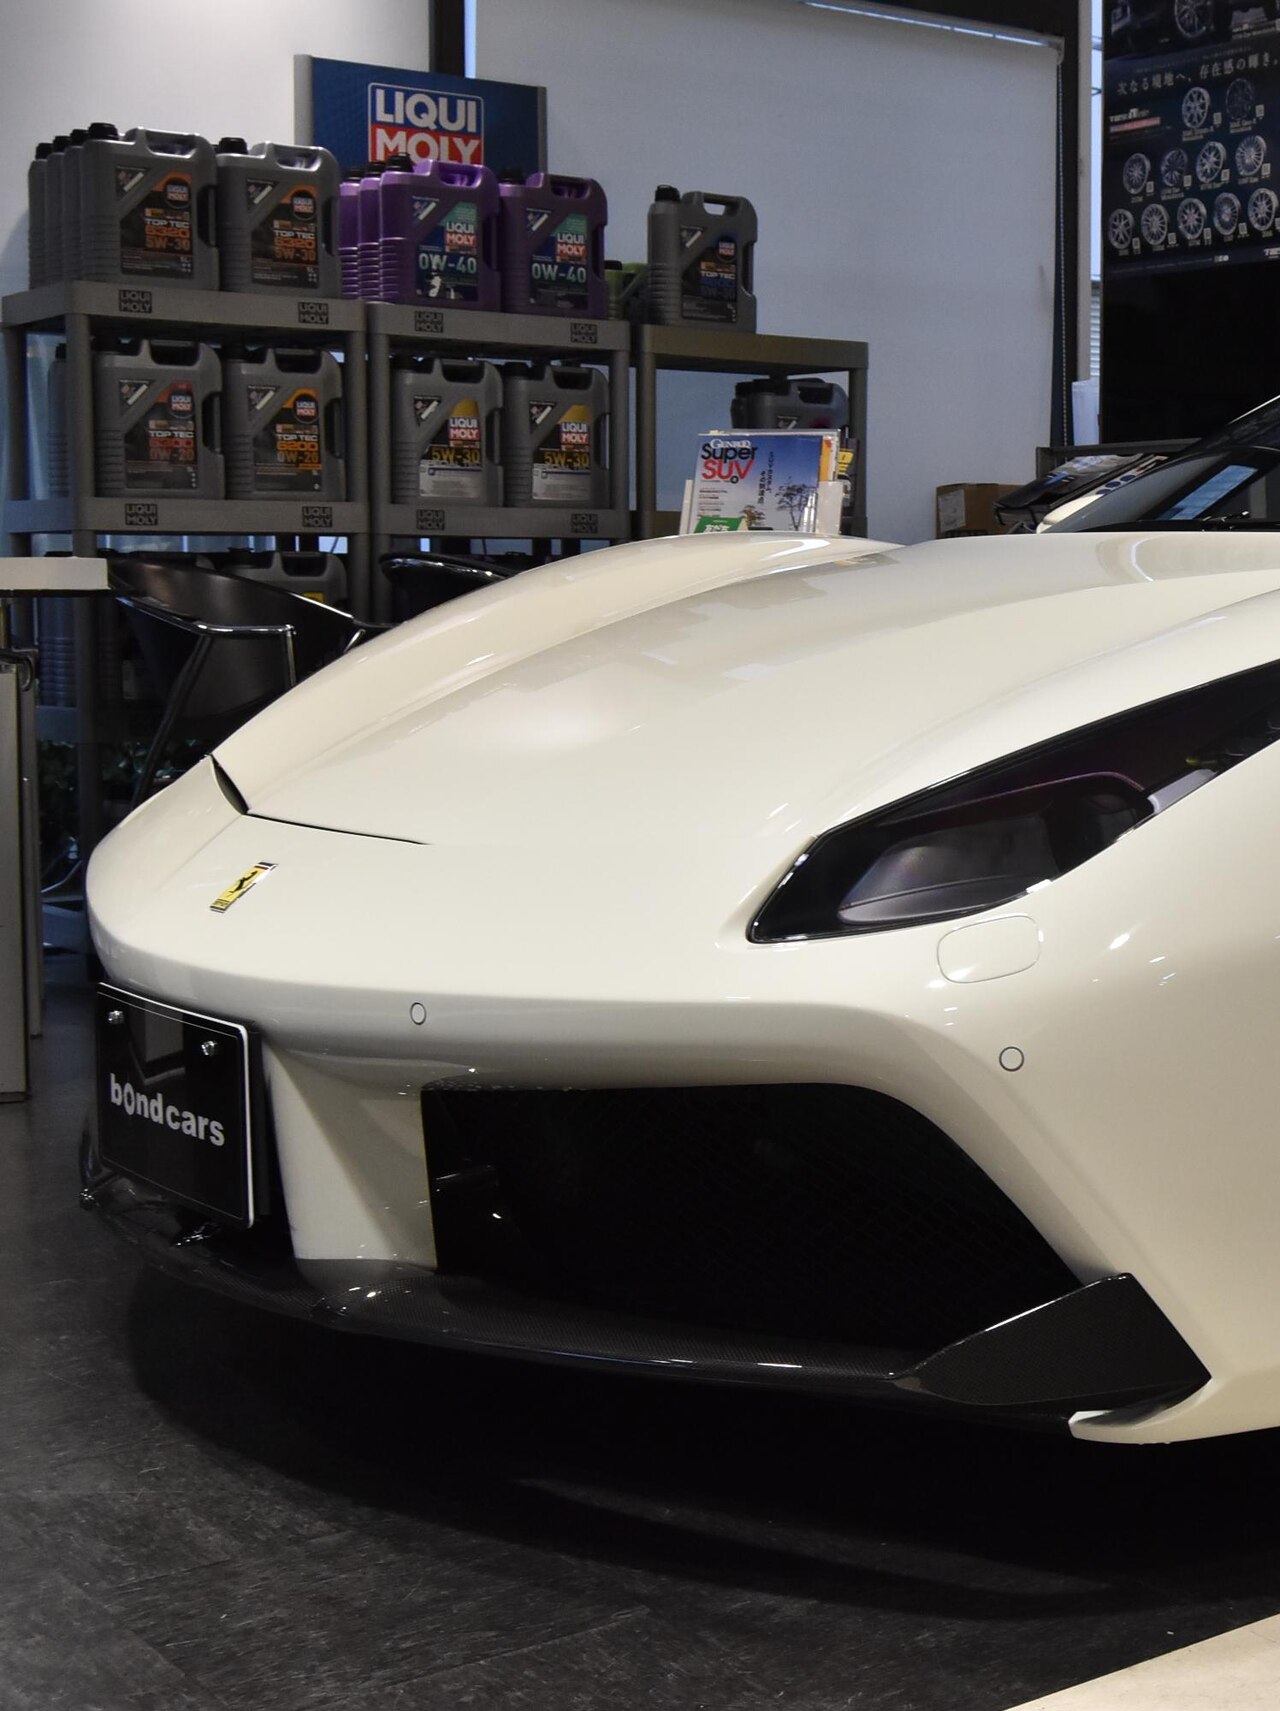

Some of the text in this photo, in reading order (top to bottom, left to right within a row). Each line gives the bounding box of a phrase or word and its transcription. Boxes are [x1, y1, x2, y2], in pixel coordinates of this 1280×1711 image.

[375, 88, 477, 133] LIQUI
[376, 128, 481, 165] MOLY
[144, 218, 190, 228] TOP TEC
[446, 222, 475, 234] LIQUI
[274, 230, 315, 240] TOP TEC
[446, 233, 476, 246] MOLY
[557, 232, 585, 244] LIQUI
[557, 243, 586, 256] MOLY
[418, 253, 477, 274] 0W-40
[532, 263, 587, 283] 0W-40
[120, 301, 151, 313] MOLY
[300, 313, 328, 324] MOLY
[415, 321, 443, 333] MOLY
[450, 416, 478, 429] LIQUI
[562, 422, 588, 433] LIQUI
[173, 431, 194, 439] TEC
[276, 433, 318, 442] TOP TEC
[450, 428, 479, 440] MOLY
[562, 432, 588, 443] MOLY
[432, 449, 481, 464] 5W-30
[544, 452, 589, 466] 5W-30
[701, 443, 759, 463] Super
[702, 458, 755, 480] SUV
[126, 514, 158, 525] MOLY
[303, 516, 332, 527] MOLY
